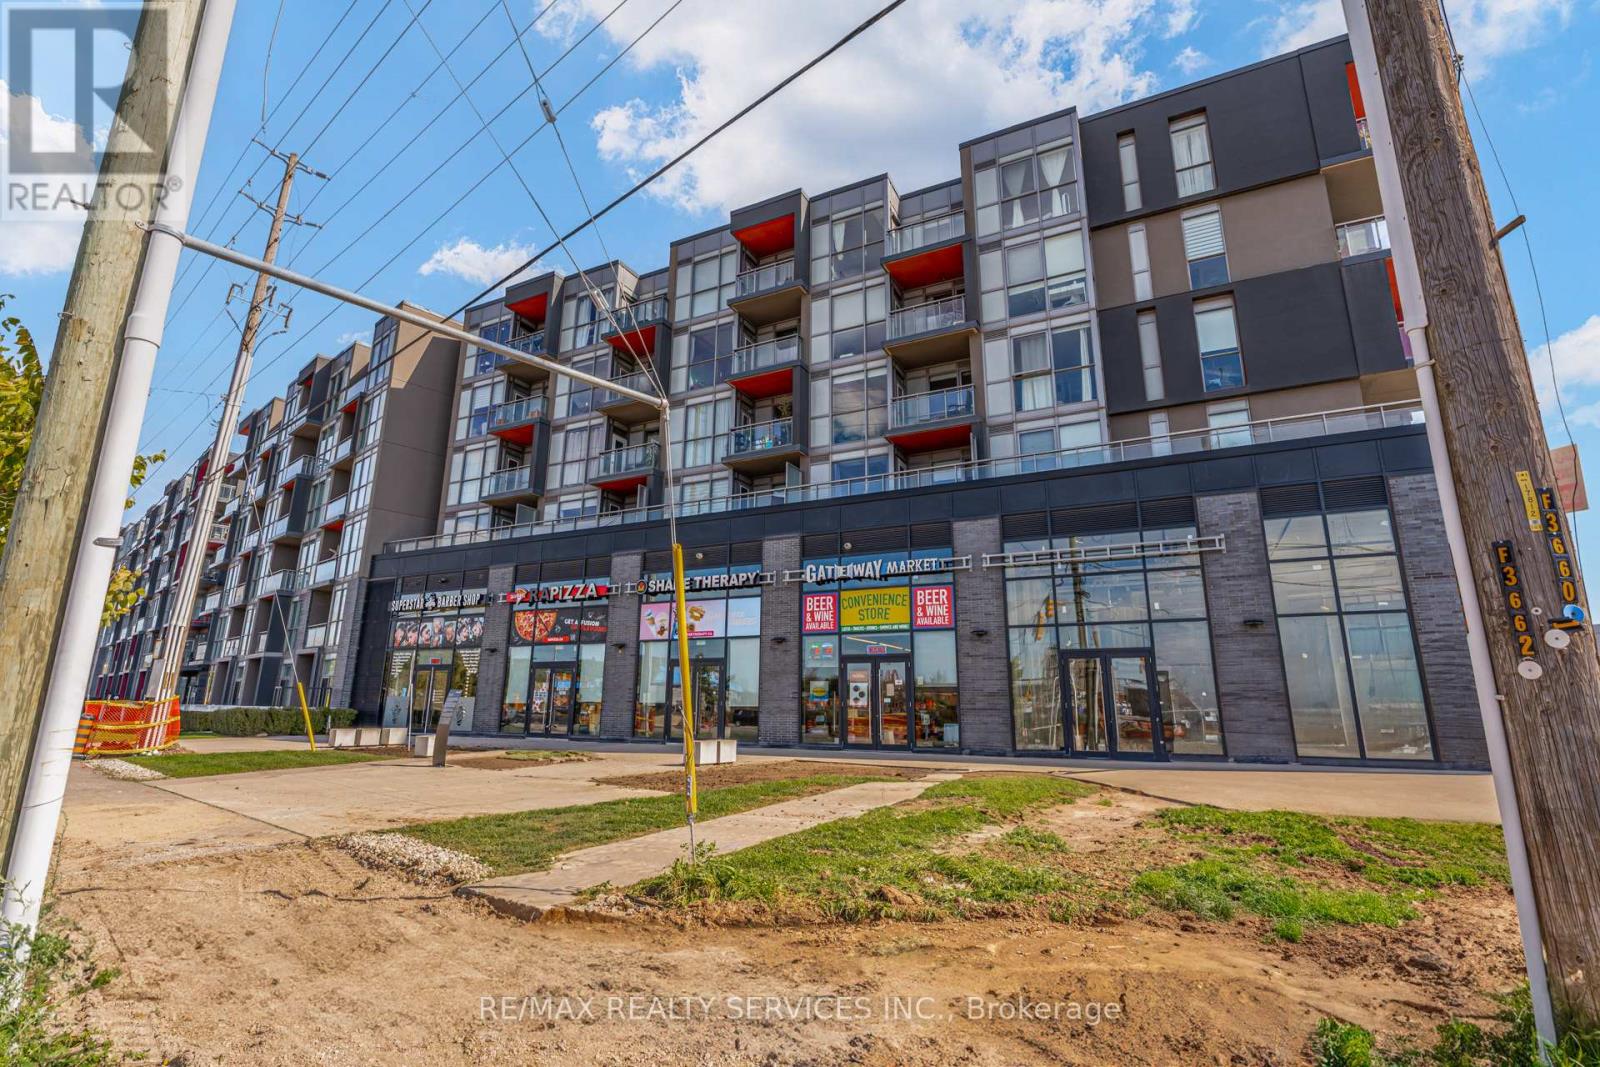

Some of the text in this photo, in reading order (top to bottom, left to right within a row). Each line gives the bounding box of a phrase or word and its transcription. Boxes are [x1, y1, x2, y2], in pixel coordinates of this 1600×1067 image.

[806, 558, 938, 583] GATEWAY MARKET
[648, 572, 756, 592] SHAE THERAPY
[391, 593, 481, 611] SUPERSTAR BARBER SHOP
[806, 596, 833, 611] BEER
[841, 594, 908, 610] CONVENIENCE
[916, 589, 948, 605] BEER
[806, 610, 834, 622] & WINE
[858, 608, 890, 621] STORE
[916, 604, 949, 617] & WINE
[805, 621, 834, 630] AVAILABLE
[916, 616, 949, 625] AVAILABLE
